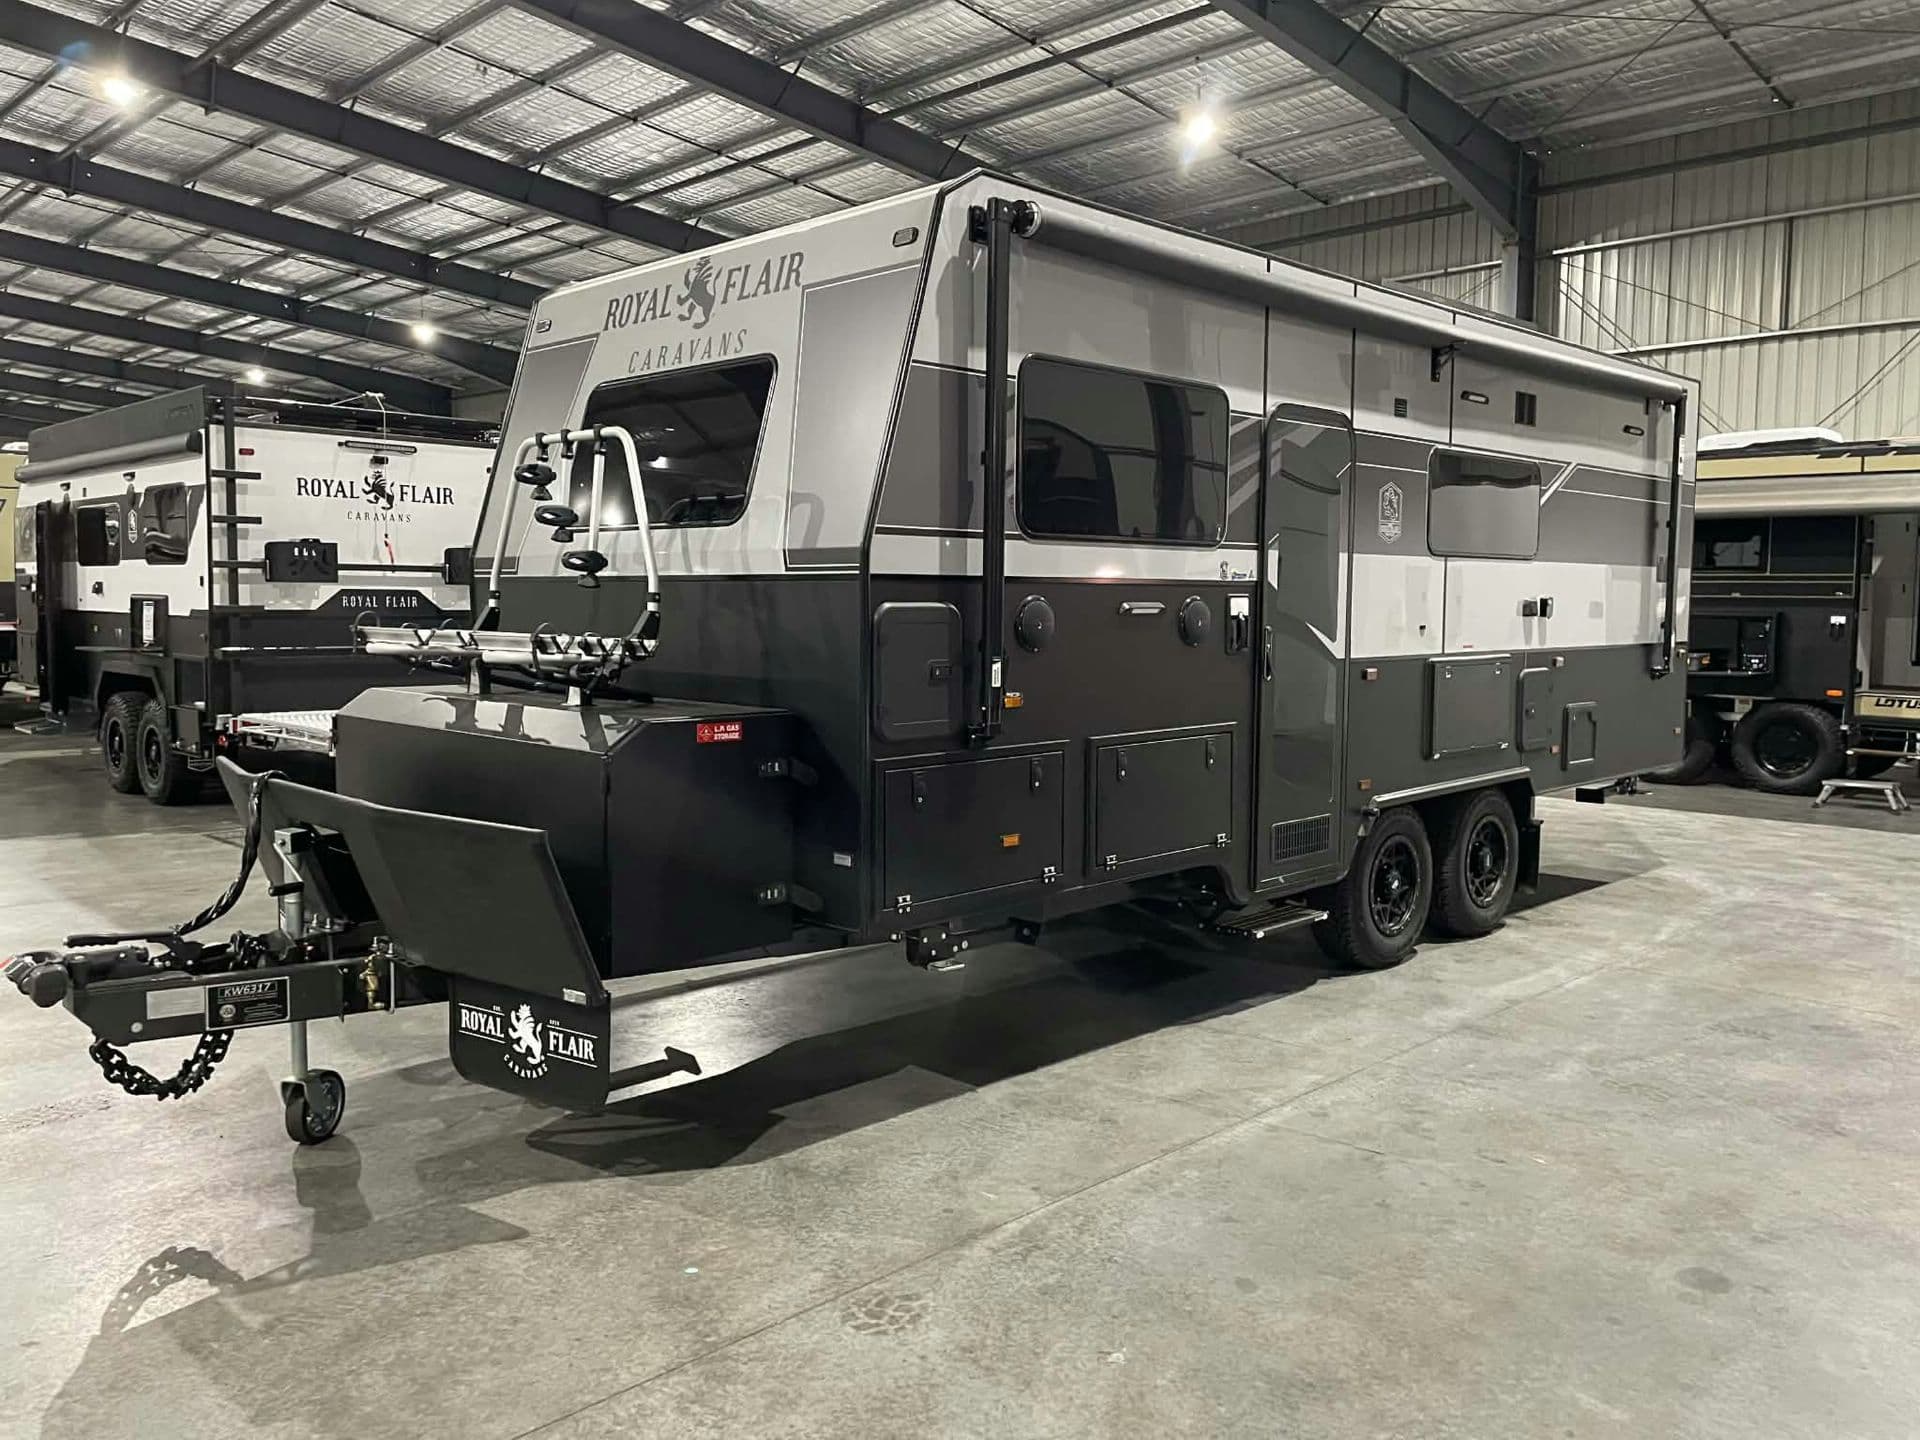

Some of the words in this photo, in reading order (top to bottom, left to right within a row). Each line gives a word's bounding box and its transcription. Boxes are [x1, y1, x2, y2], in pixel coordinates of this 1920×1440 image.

[603, 284, 672, 331] ROYAL
[721, 251, 804, 305] FLAIR
[628, 328, 747, 374] CARAVANS
[296, 477, 360, 499] ROYAL
[399, 484, 454, 505] FLAIR
[347, 511, 411, 523] CARAVANS
[342, 595, 378, 608] ROYAL
[386, 595, 418, 608] FLAIR
[224, 982, 272, 997] KW6317
[460, 1008, 505, 1038] ROYAL
[549, 1031, 595, 1061] FLAIR
[503, 1053, 548, 1079] CARAVANS
